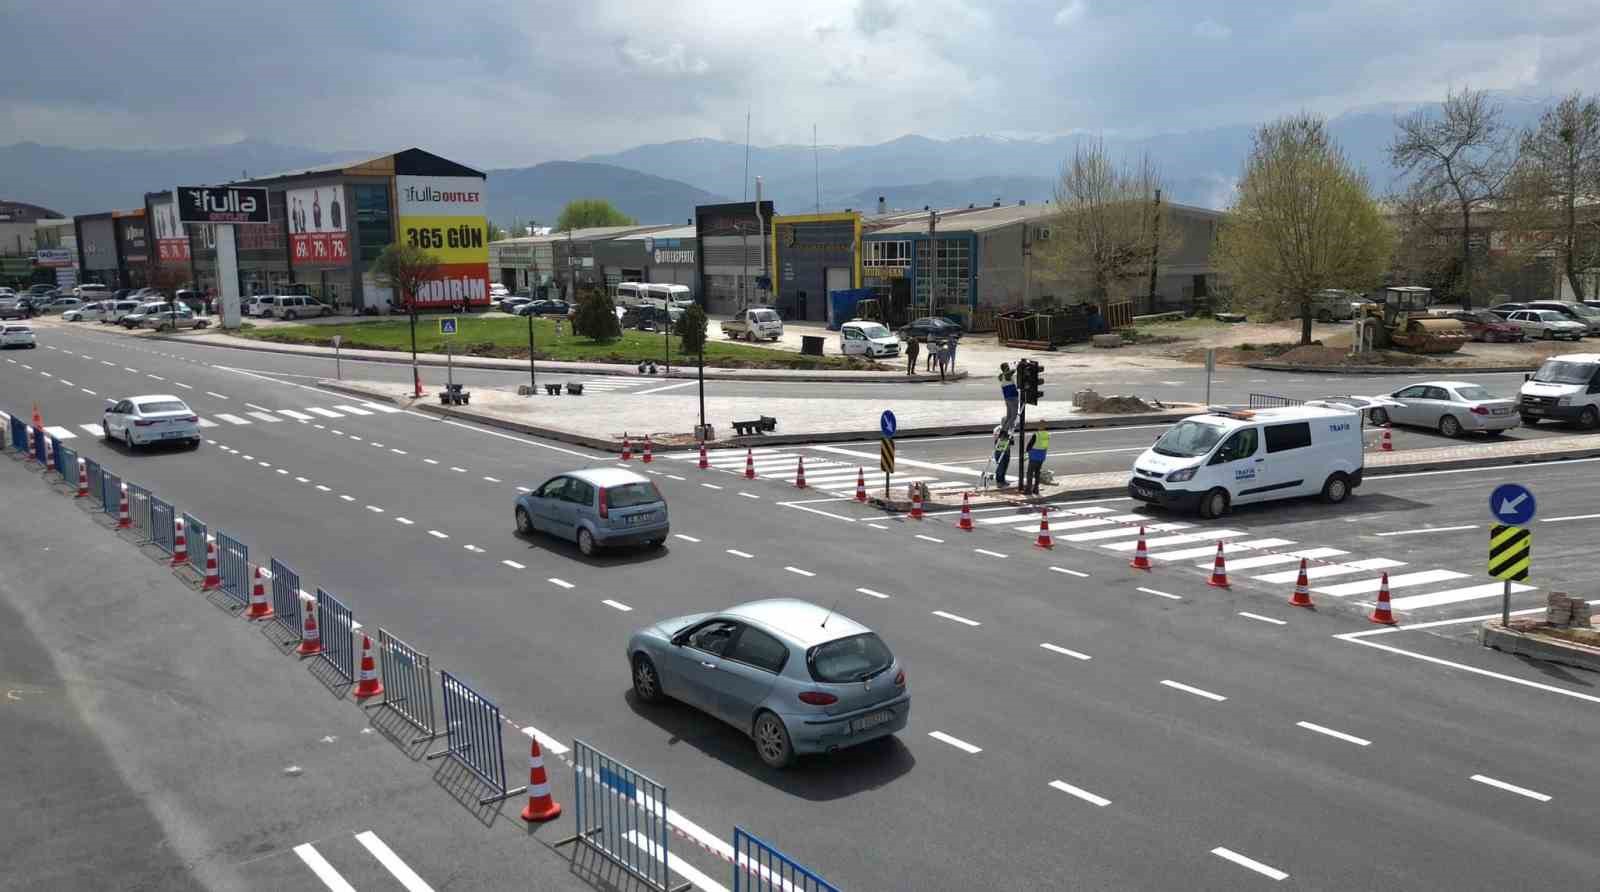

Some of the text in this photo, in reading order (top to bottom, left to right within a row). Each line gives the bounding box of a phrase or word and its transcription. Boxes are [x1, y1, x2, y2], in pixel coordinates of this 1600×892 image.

[201, 190, 257, 212] fulla
[408, 185, 480, 202] fulla OUTLET
[407, 224, 483, 249] 365 GÜN
[412, 275, 486, 302] NDİRİM
